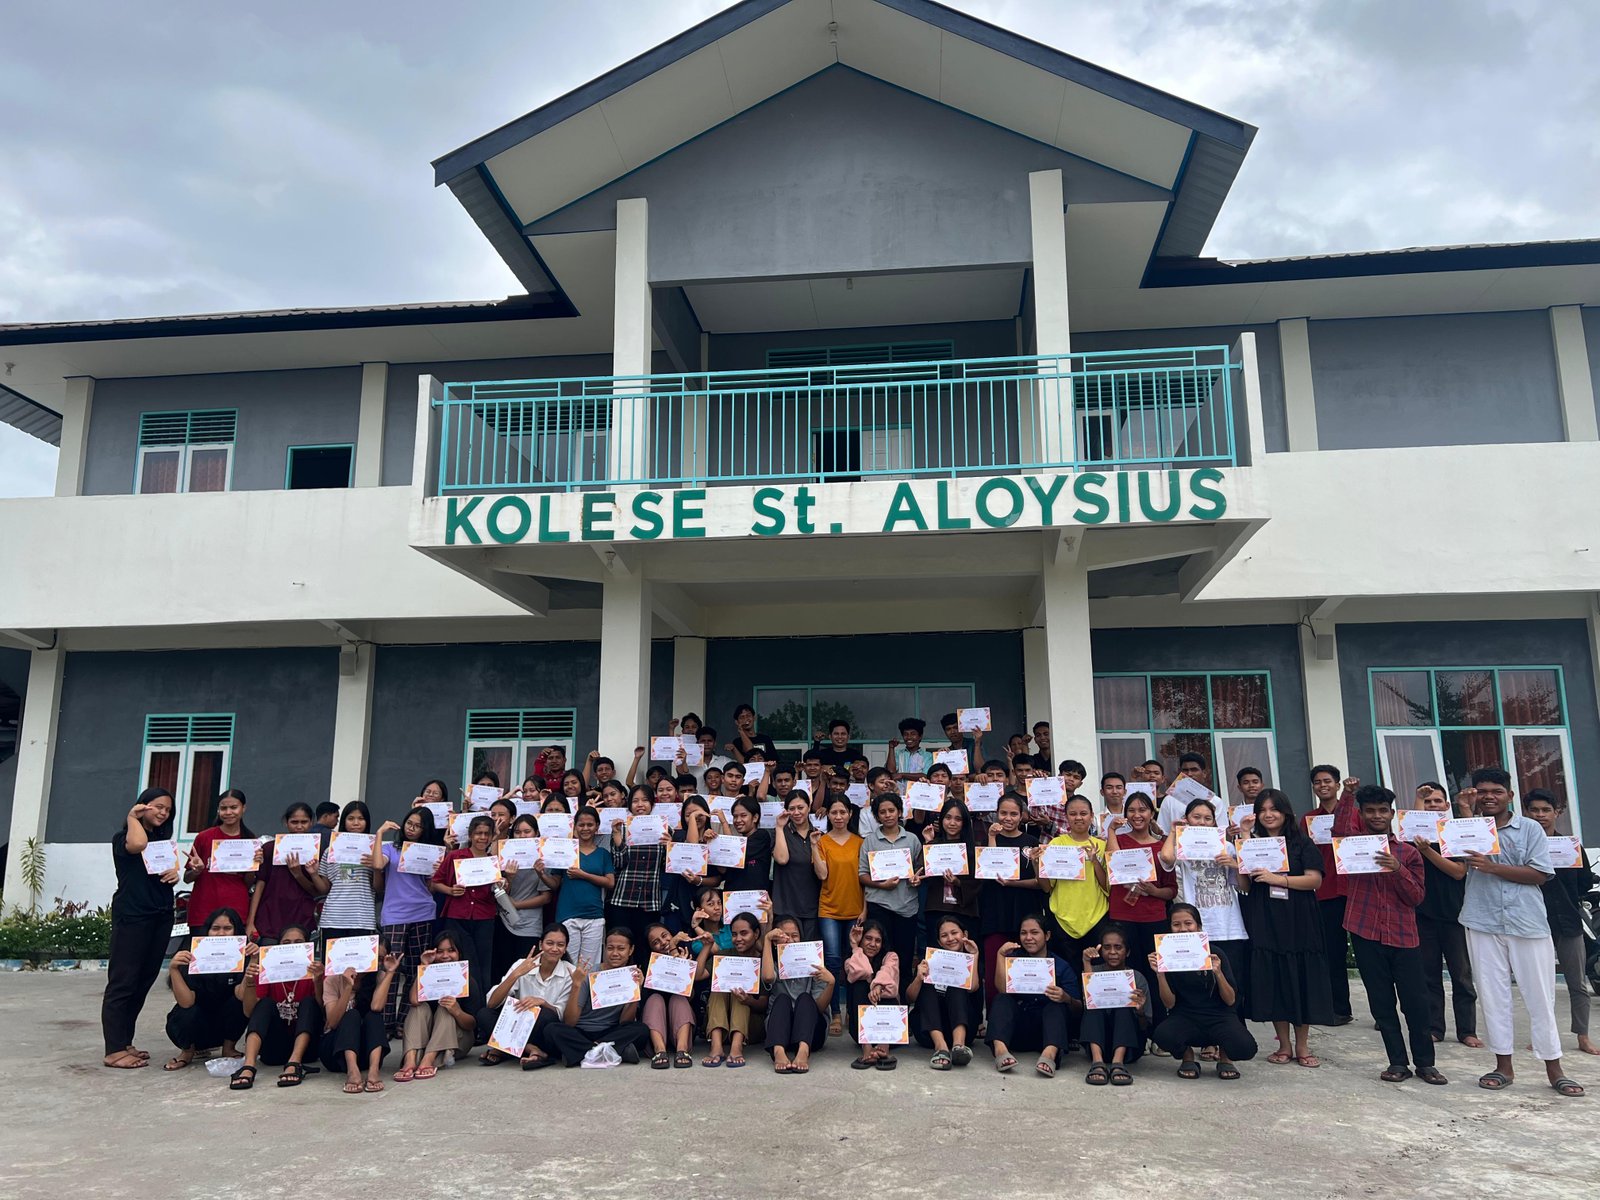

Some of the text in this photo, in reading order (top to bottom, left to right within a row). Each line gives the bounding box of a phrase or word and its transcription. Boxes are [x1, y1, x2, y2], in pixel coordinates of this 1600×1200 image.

[445, 468, 1227, 545] KOLESE St. ALOYSIUS
